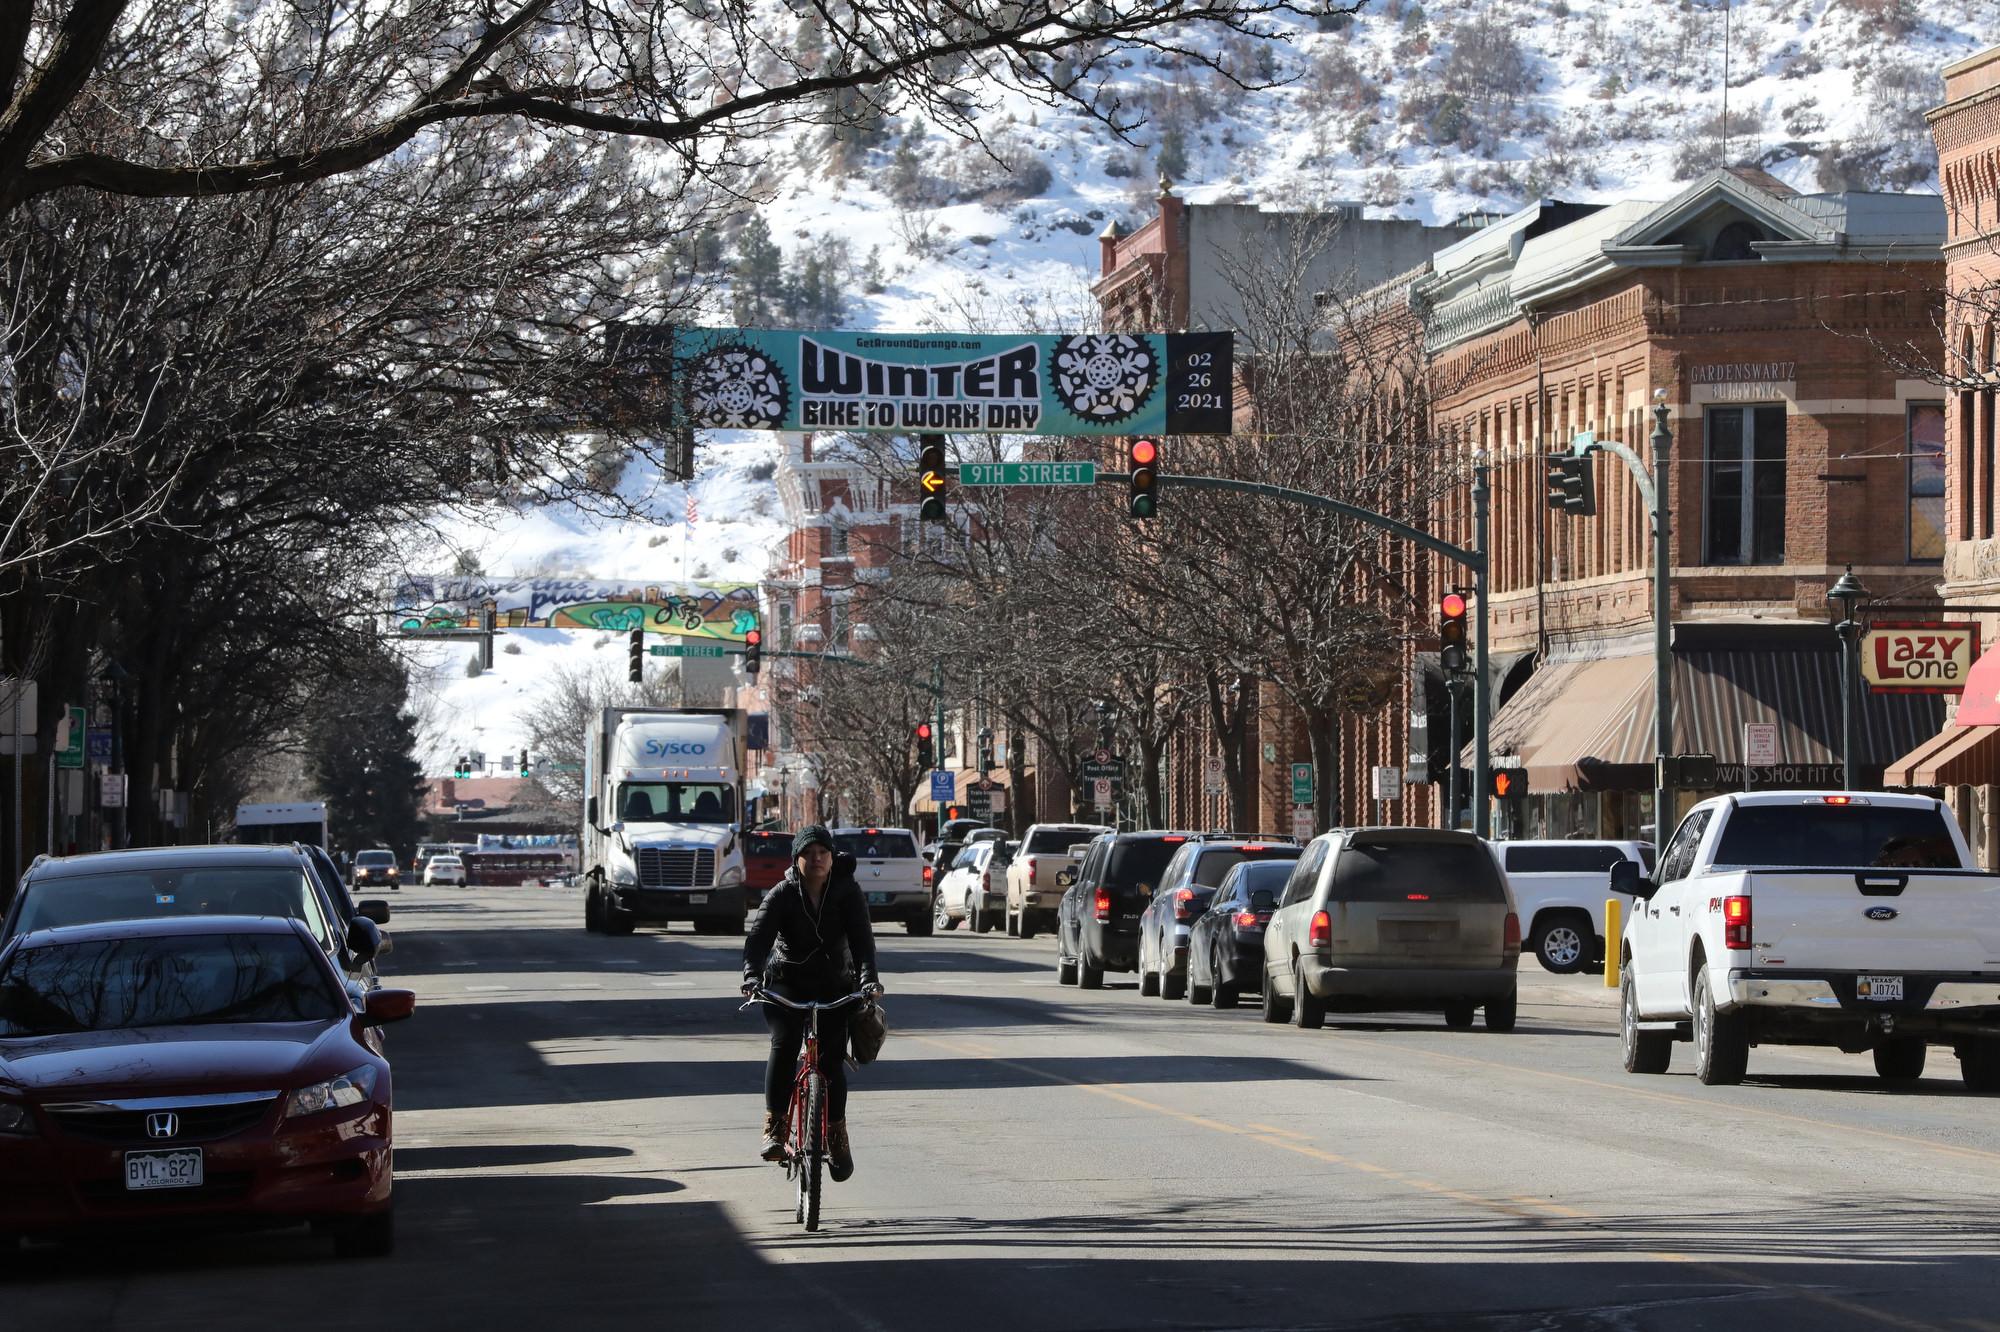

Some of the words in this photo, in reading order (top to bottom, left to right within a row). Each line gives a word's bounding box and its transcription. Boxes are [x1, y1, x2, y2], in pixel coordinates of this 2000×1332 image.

[856, 337, 981, 350] GetAroundDurango.com
[1188, 353, 1212, 367] 02
[1691, 361, 1796, 382] GARDENSWARTZ
[1188, 373, 1212, 387] 26
[1178, 393, 1223, 409] 2021
[802, 400, 859, 426] BIKE
[865, 402, 896, 427] TO
[902, 402, 980, 428] WORK
[987, 403, 1039, 429] DAY
[971, 465, 1004, 483] 9TH
[1018, 464, 1083, 483] STREET
[656, 646, 675, 656] 8TH
[681, 646, 717, 657] STREET
[646, 739, 706, 758] Sysco
[1808, 766, 1828, 783] FIT
